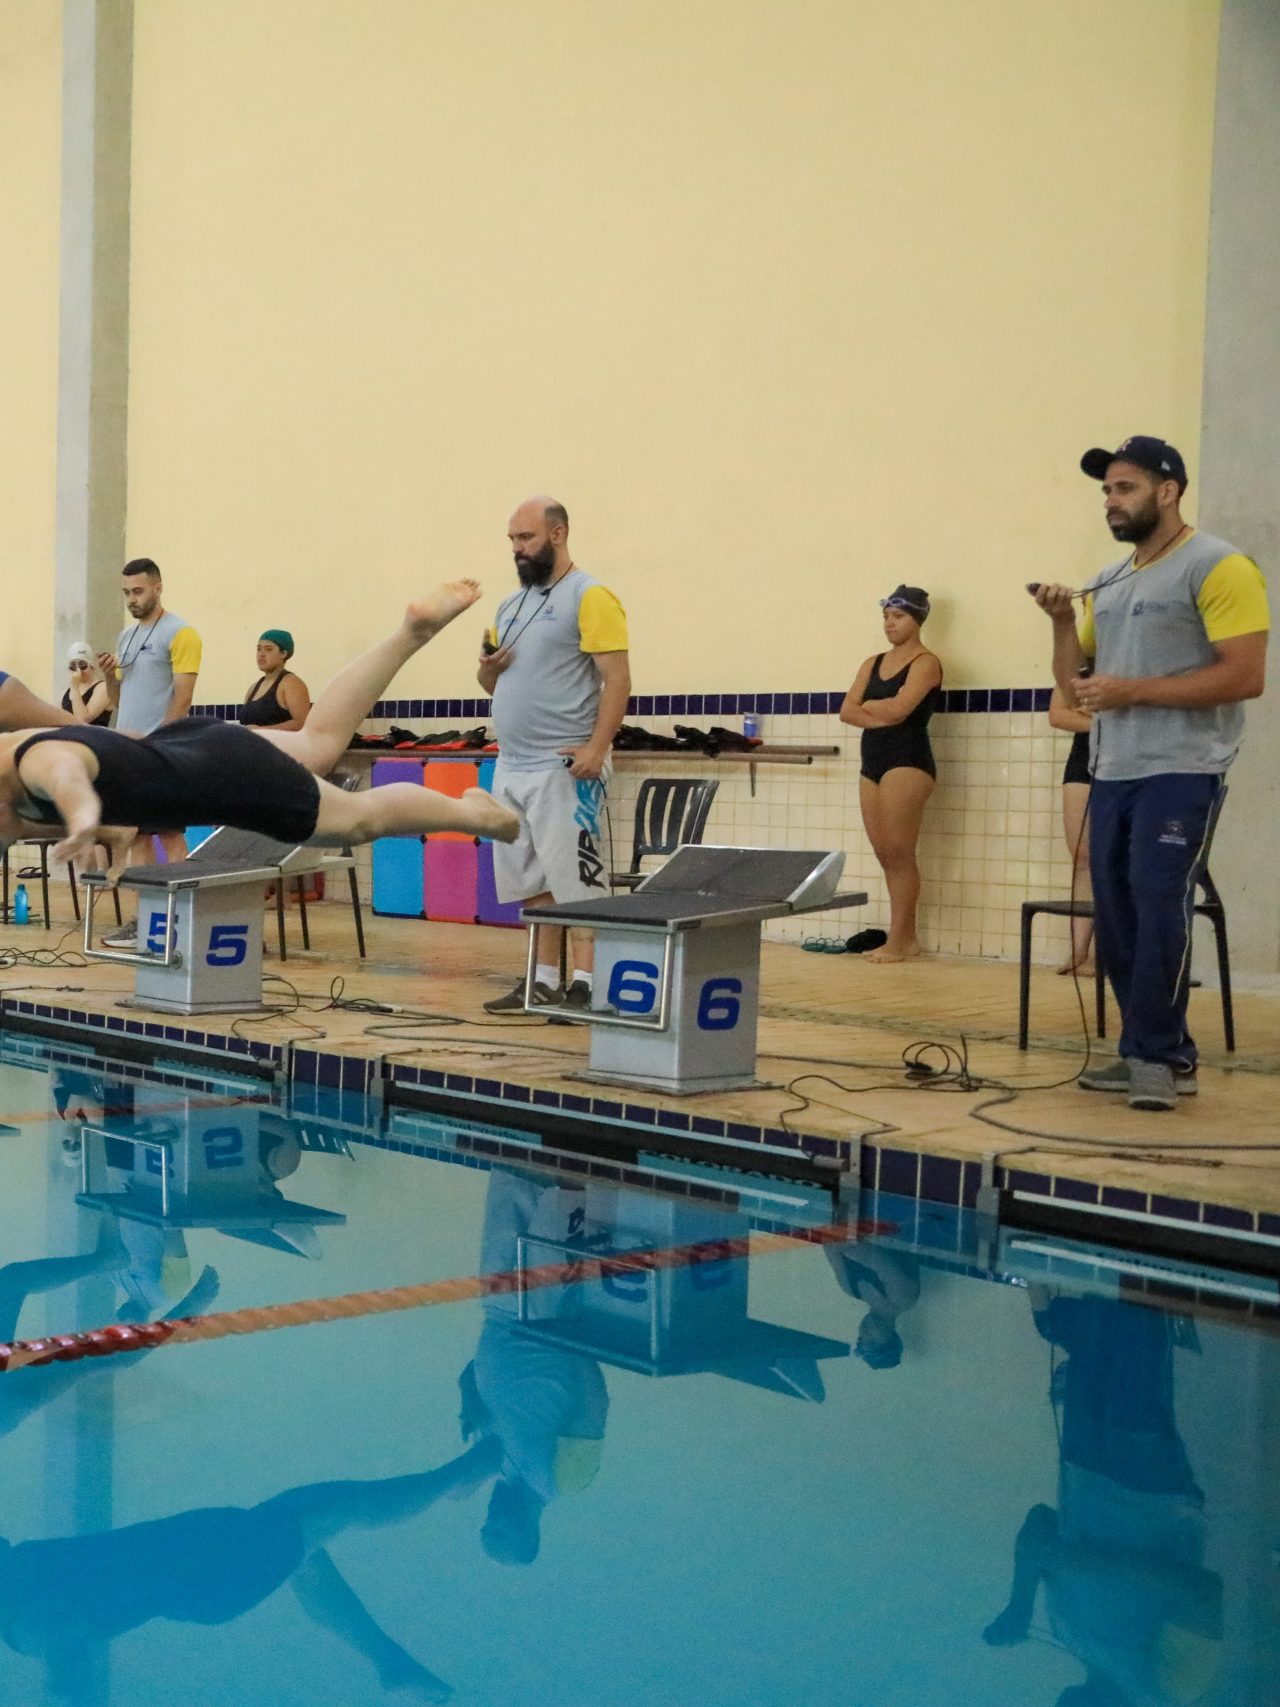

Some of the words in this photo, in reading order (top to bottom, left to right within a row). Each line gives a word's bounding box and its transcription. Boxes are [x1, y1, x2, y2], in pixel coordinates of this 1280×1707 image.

[578, 829, 607, 891] RIP
[147, 912, 179, 954] 5
[206, 925, 248, 966] 5
[607, 960, 659, 1013] 6
[697, 978, 742, 1030] 6
